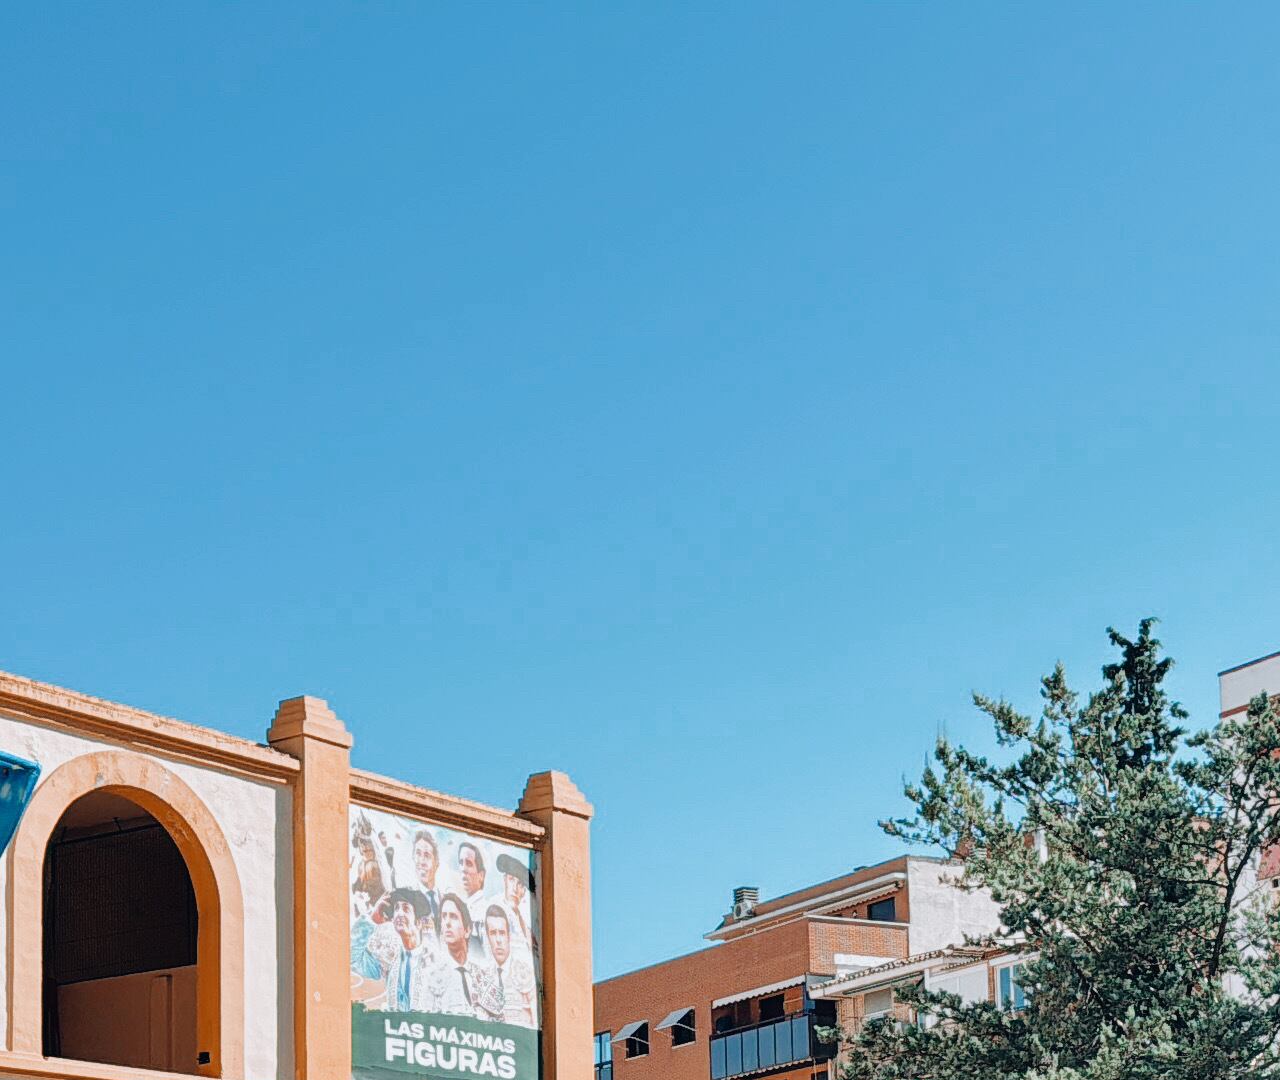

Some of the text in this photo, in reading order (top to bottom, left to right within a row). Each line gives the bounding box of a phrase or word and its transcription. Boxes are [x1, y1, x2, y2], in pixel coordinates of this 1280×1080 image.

[384, 1018, 516, 1054] LAS MÁXIMAS
[385, 1037, 517, 1080] FIGURAS
